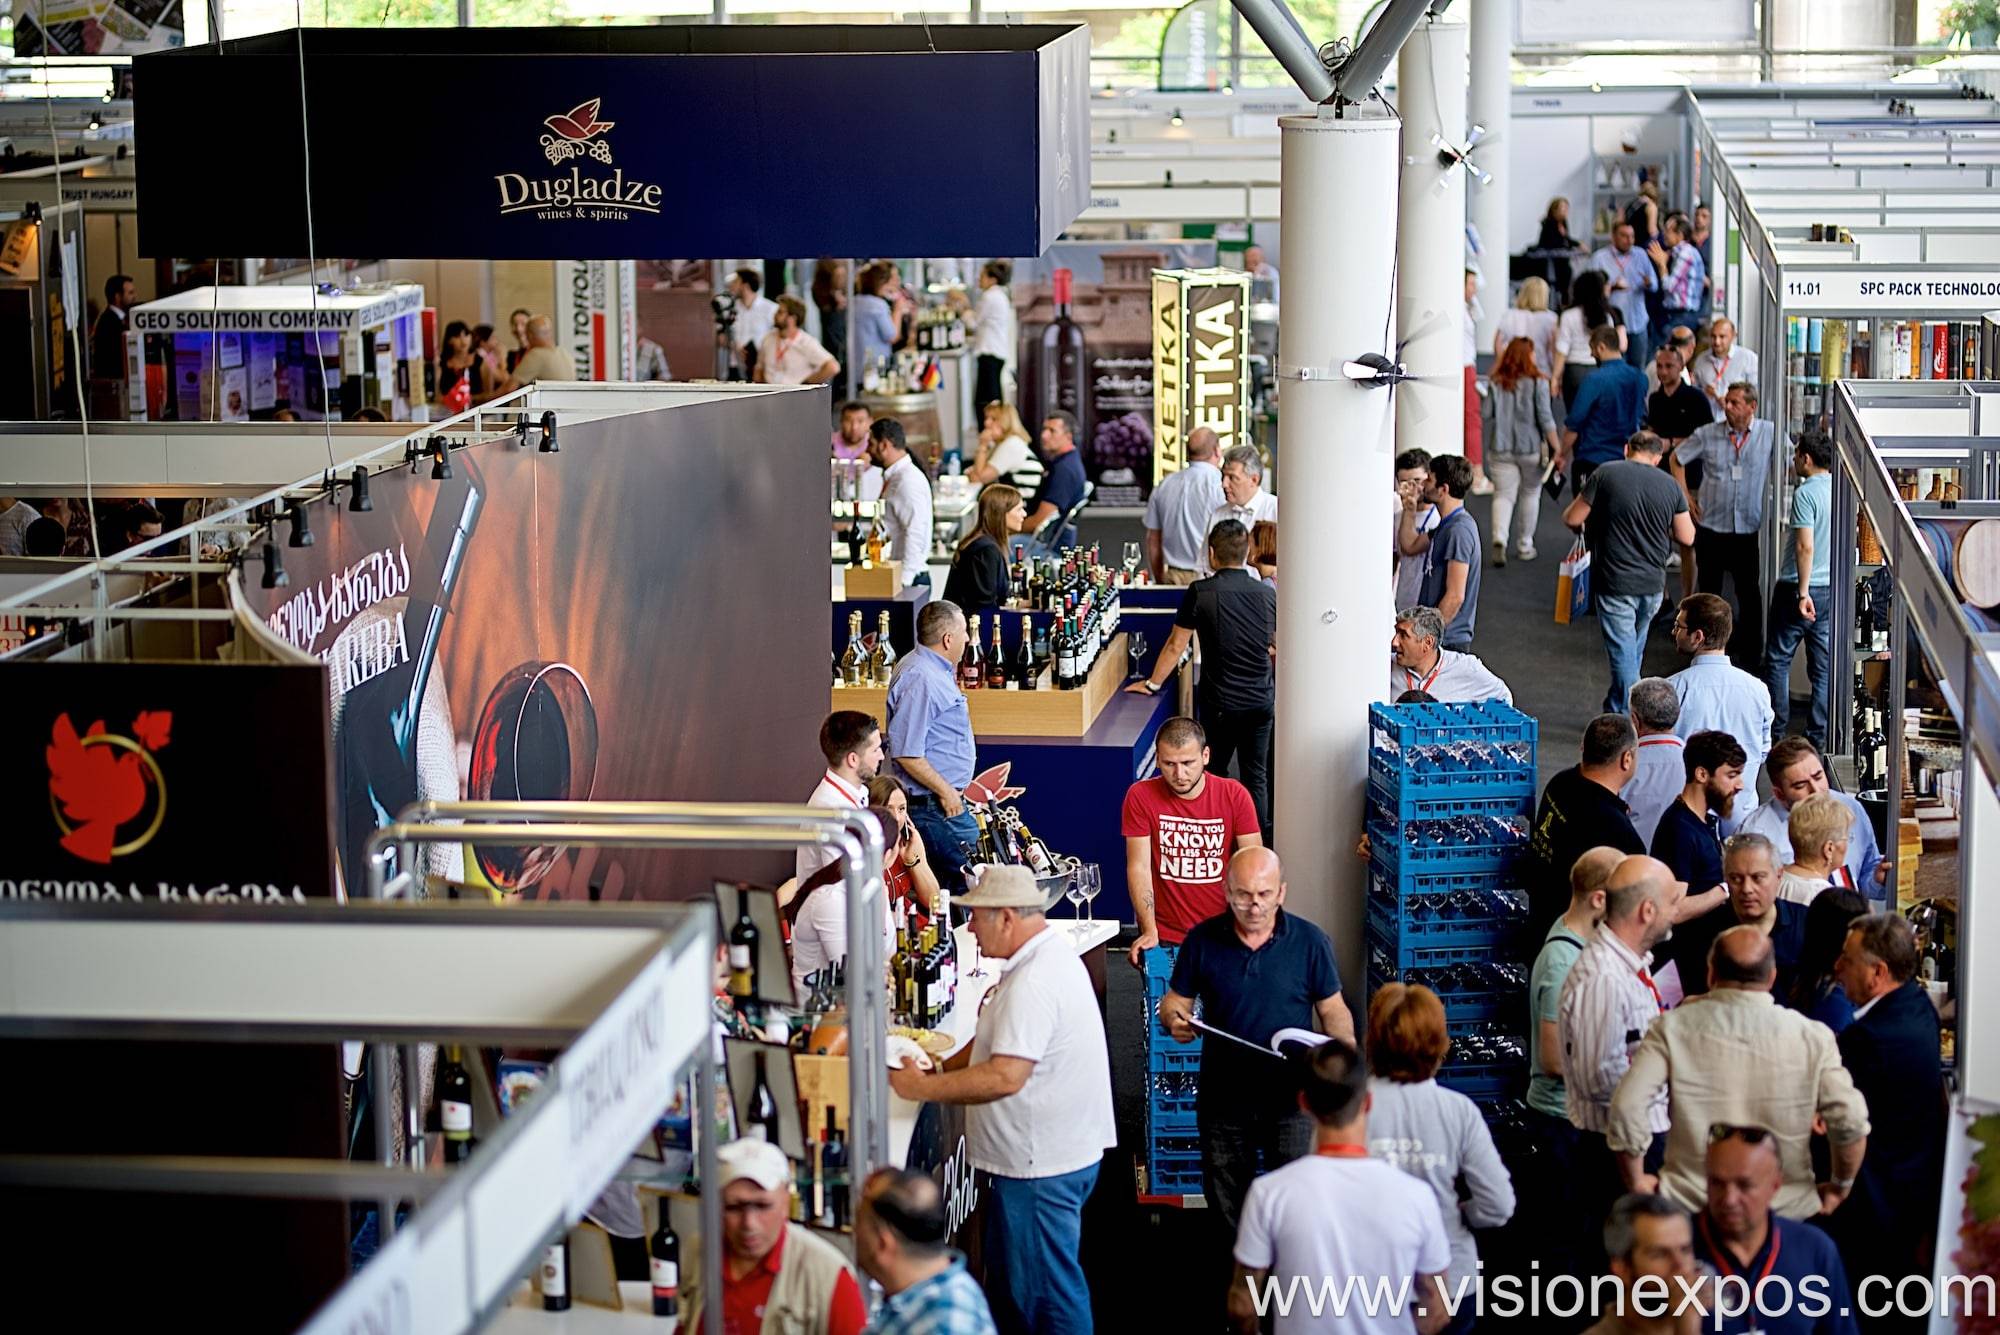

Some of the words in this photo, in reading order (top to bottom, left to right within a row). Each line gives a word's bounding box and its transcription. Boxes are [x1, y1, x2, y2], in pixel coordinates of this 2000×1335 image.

[494, 166, 662, 207] Dugladze
[537, 209, 572, 220] wines
[575, 207, 586, 218] &
[590, 208, 628, 220] spirits
[1788, 282, 1821, 296] 11.01
[1860, 282, 1885, 296] SPC
[1889, 282, 1922, 296] PACK
[135, 312, 171, 329] GEO
[176, 312, 262, 329] SOLUTION
[269, 312, 353, 329] COMPANY
[1160, 821, 1176, 831] THE
[1178, 823, 1202, 833] MORE
[1205, 824, 1224, 834] YOU
[1159, 830, 1224, 850] KNOW
[1160, 845, 1177, 857] THE
[1181, 848, 1200, 858] LESS
[1203, 848, 1224, 858] YOU
[1160, 854, 1224, 878] NEED
